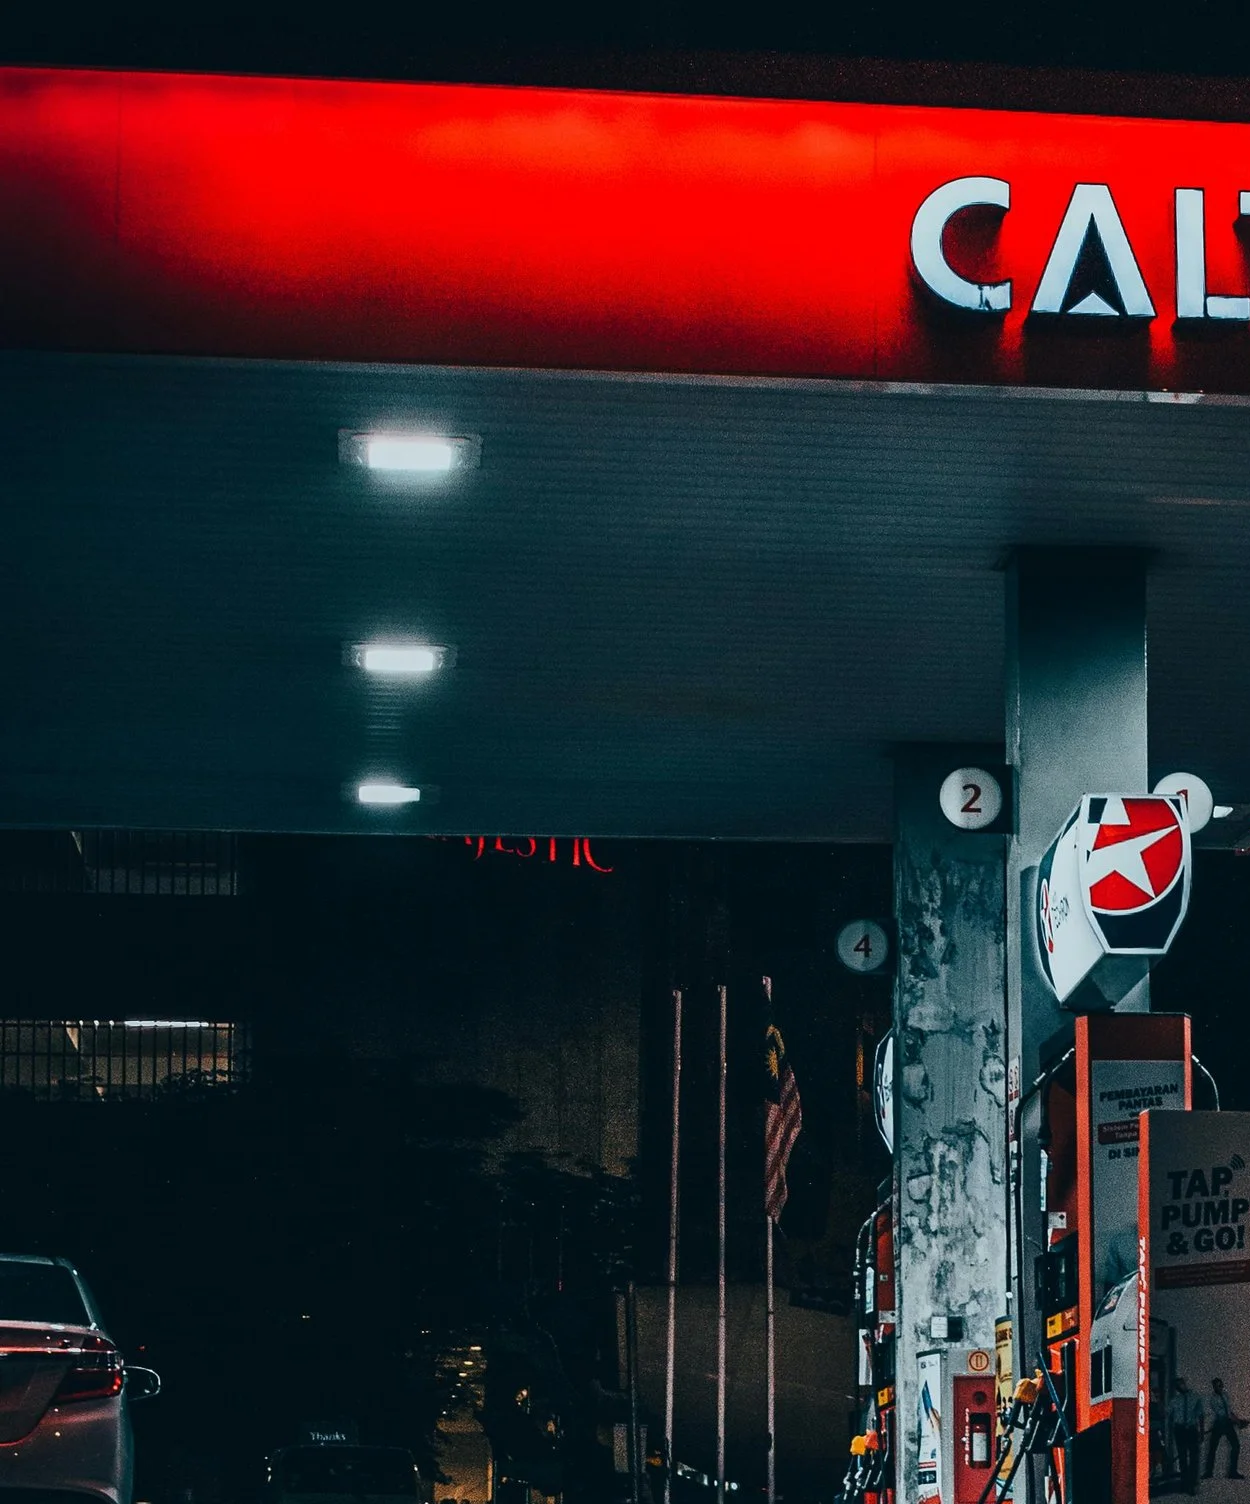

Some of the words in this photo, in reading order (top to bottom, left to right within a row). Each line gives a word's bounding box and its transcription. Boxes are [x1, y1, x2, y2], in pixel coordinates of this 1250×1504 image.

[961, 783, 982, 813] 2
[853, 934, 873, 958] 4
[1099, 1084, 1178, 1102] PEMBAYARAN
[1118, 1096, 1163, 1110] PANTAS
[1108, 1148, 1121, 1160] DI
[1161, 1198, 1249, 1231] PUMP
[1166, 1231, 1189, 1256] &
[1193, 1224, 1245, 1253] GO!
[1138, 1291, 1147, 1364] PUMP
